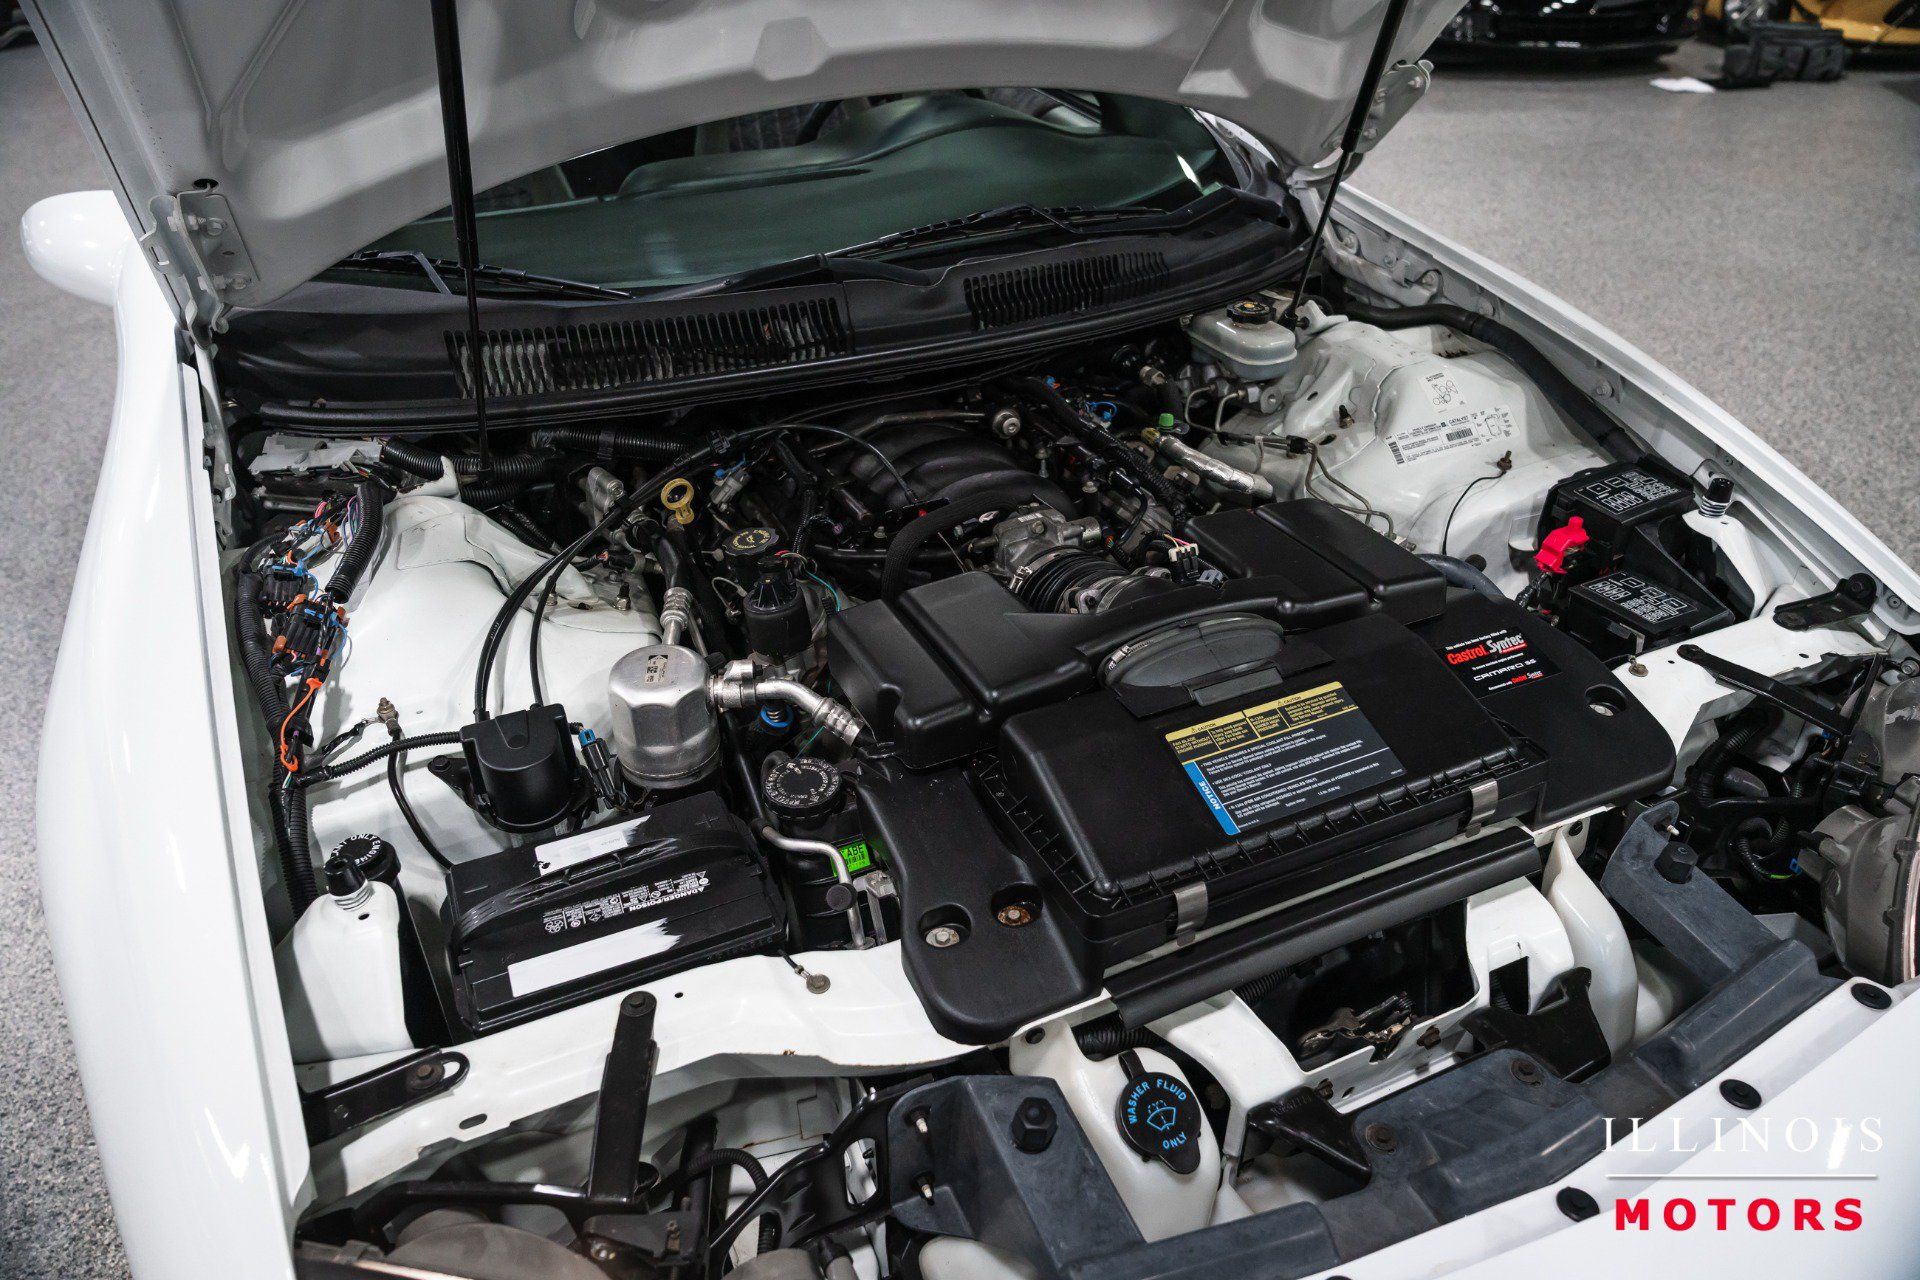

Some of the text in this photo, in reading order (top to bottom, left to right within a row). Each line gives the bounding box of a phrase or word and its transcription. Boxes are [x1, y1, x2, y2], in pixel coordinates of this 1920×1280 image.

[1447, 644, 1487, 665] Castrol
[1486, 634, 1524, 654] Syntec
[1473, 662, 1524, 681] CAMARO
[1198, 780, 1221, 810] NOTICE
[354, 840, 380, 866] ENGINE
[629, 887, 700, 912] DANGER/POISON
[1128, 1078, 1187, 1150] WASHER FLUID ONLY
